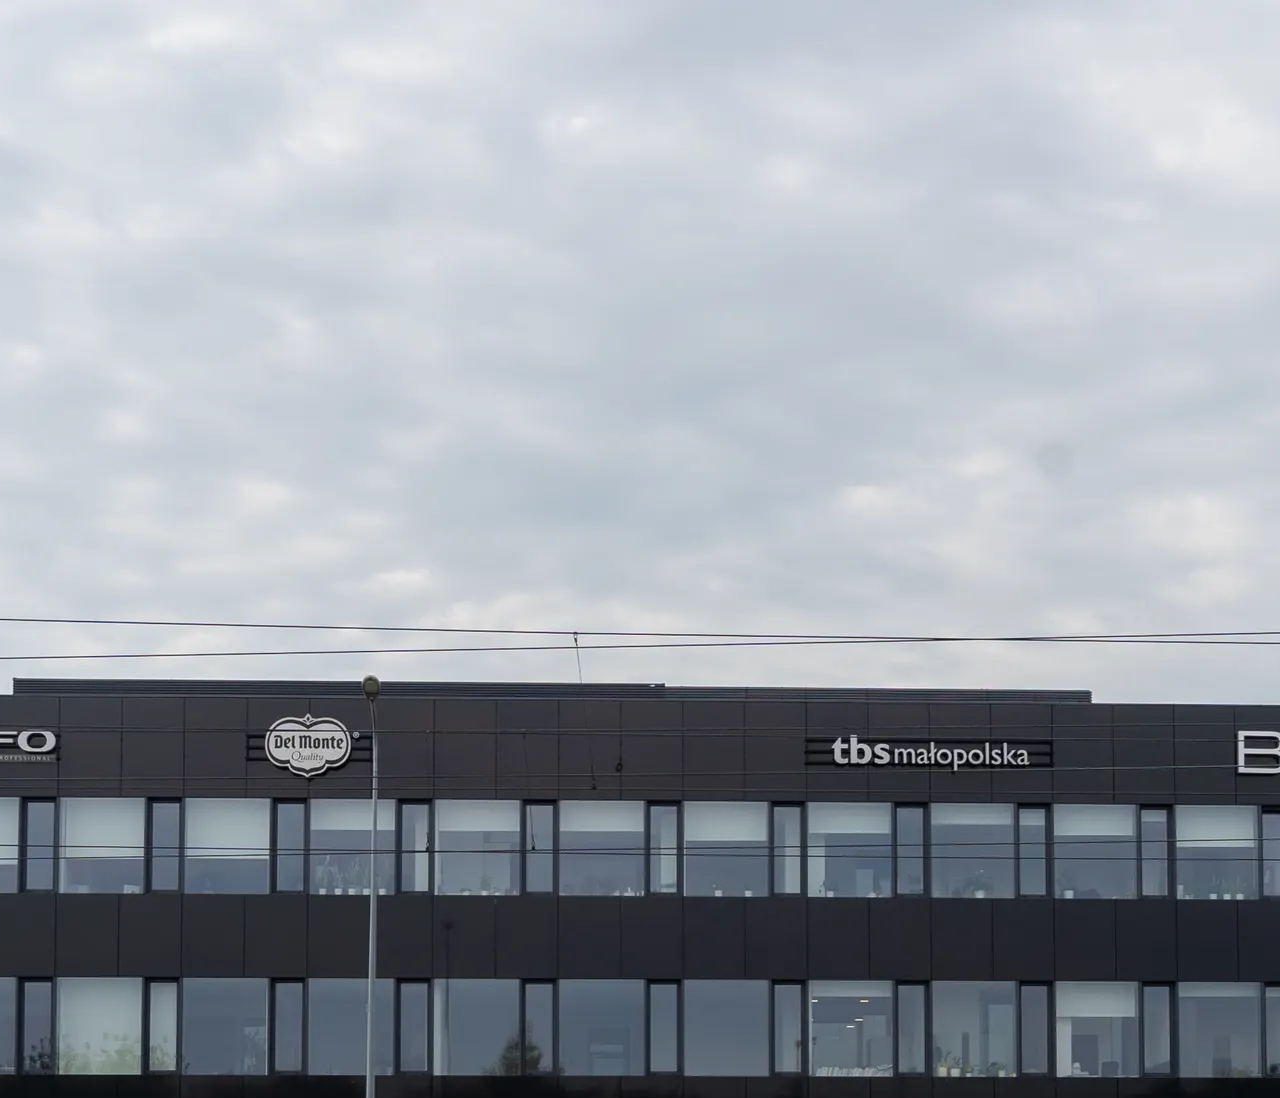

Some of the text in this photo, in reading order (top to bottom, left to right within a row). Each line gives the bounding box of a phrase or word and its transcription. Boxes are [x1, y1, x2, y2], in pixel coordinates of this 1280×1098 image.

[273, 734, 344, 750] Del Monte
[291, 751, 324, 764] Quality
[831, 735, 1031, 771] tbs małopolska
